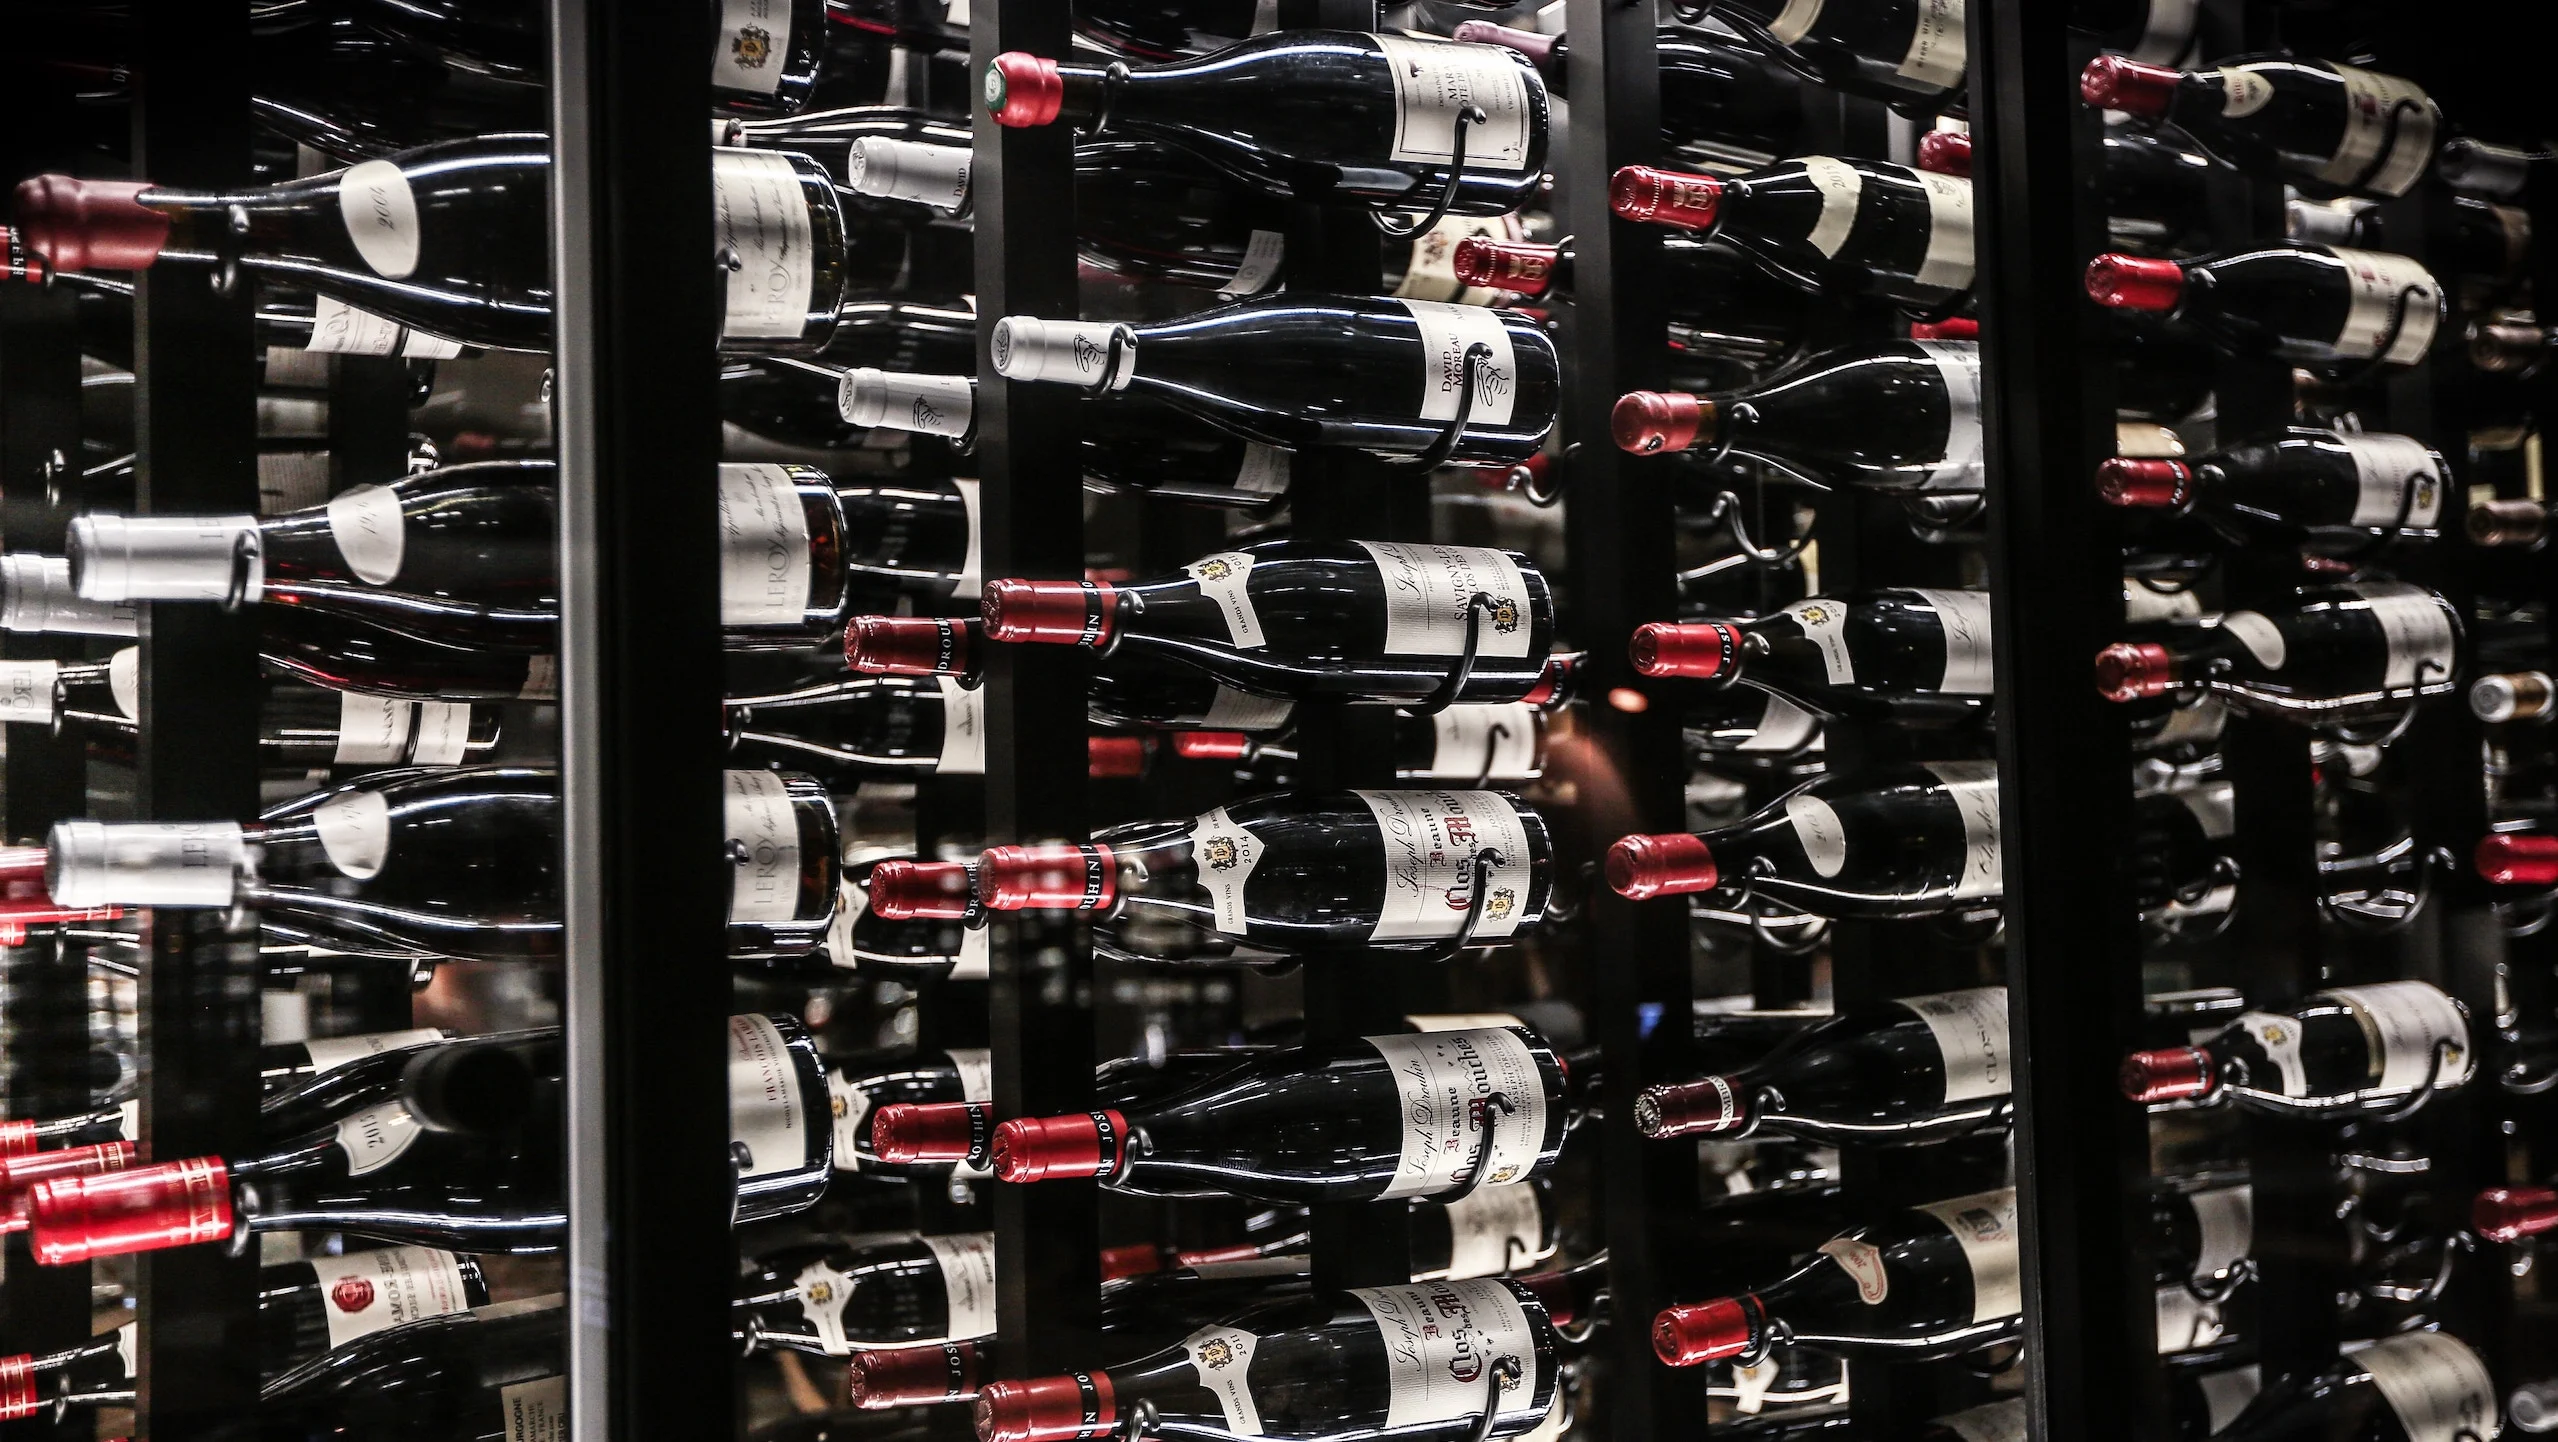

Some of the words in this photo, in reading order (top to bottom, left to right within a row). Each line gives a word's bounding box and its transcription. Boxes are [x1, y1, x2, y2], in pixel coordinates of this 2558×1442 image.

[1458, 85, 1470, 109] OTE
[953, 168, 967, 197] DAVID
[1441, 350, 1453, 393] DAVID
[1448, 332, 1464, 387] MOREAU
[765, 538, 791, 607] LEROY
[1229, 554, 1246, 571] 2011
[1382, 551, 1422, 601] Joseph
[1227, 589, 1239, 605] VINS
[1463, 573, 1480, 594] LOS
[1235, 607, 1249, 634] GRANDS
[1711, 623, 1732, 664] JOSE
[1240, 836, 1253, 864] 2014
[1419, 807, 1447, 868] Beaune
[754, 834, 780, 904] LEROY
[1394, 837, 1424, 898] Joseph
[1444, 857, 1474, 911] Clos
[1224, 883, 1232, 900] VINS
[1226, 901, 1235, 925] GRANDS
[1402, 1059, 1433, 1125] Drouhin
[1453, 1037, 1491, 1131] Mouches
[1509, 1072, 1521, 1108] JOSEPH
[360, 1113, 385, 1149] 2015
[1443, 1086, 1461, 1155] Beaune
[1406, 1128, 1438, 1180] Joseph
[1460, 1313, 1472, 1330] des
[1232, 1333, 1247, 1356] 2011
[1384, 1317, 1421, 1372] Joseph
[1446, 1329, 1482, 1383] Clos
[1226, 1379, 1238, 1396] VINS
[512, 1396, 525, 1442] URGOGNE
[1232, 1397, 1246, 1425] GRANDS
